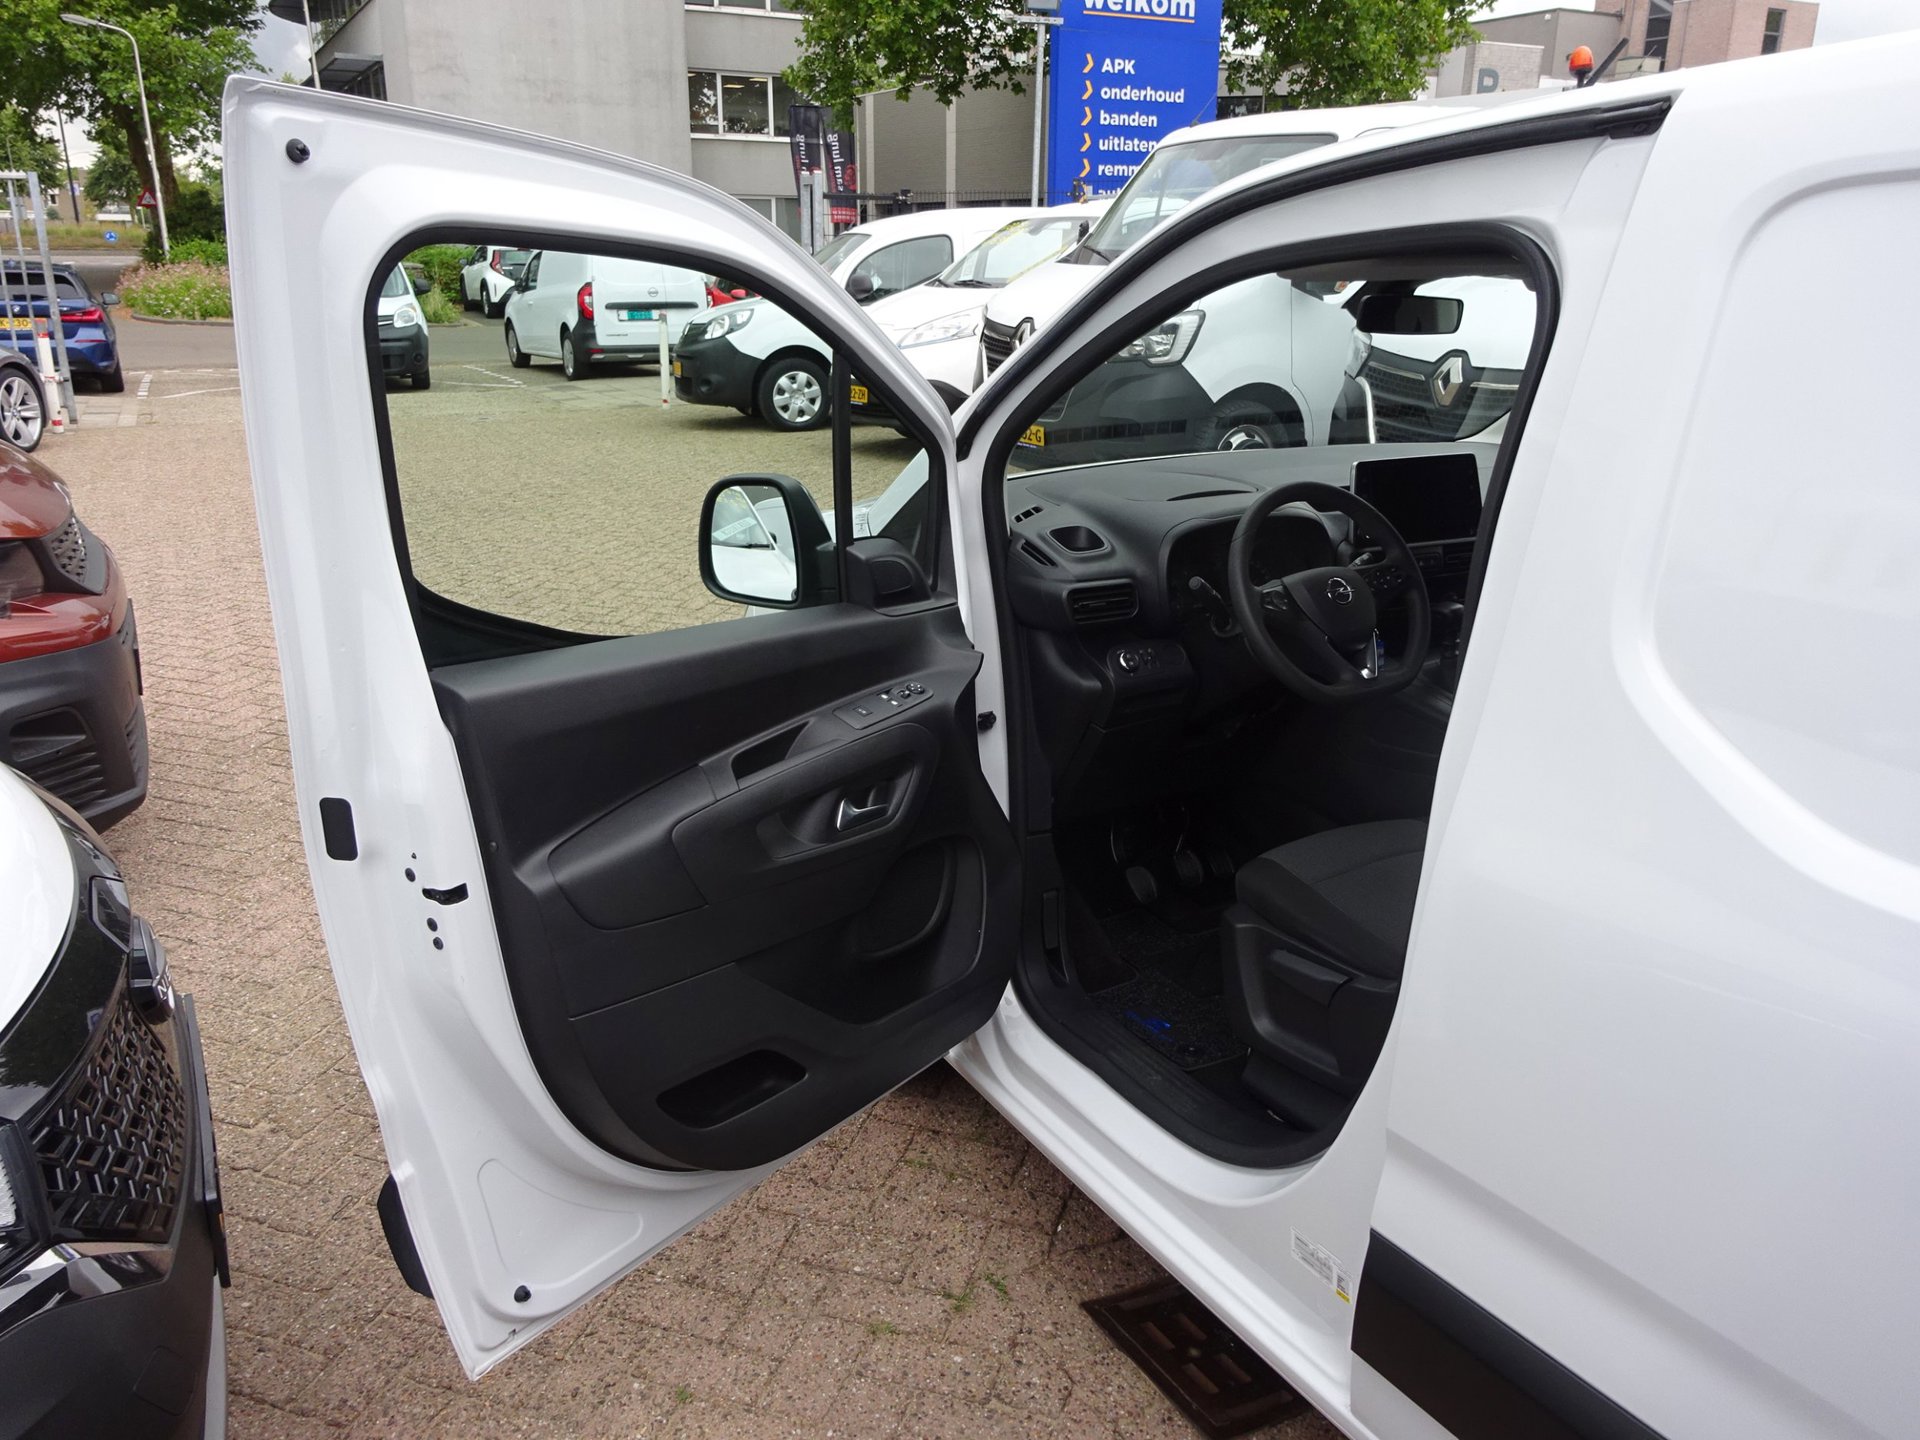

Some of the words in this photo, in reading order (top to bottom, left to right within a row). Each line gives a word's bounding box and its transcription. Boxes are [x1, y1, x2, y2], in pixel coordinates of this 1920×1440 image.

[1101, 58, 1135, 75] APK
[1101, 85, 1185, 104] onderhoud
[1099, 110, 1158, 127] banden
[1098, 136, 1159, 152] uitlaten
[1098, 164, 1141, 177] remm
